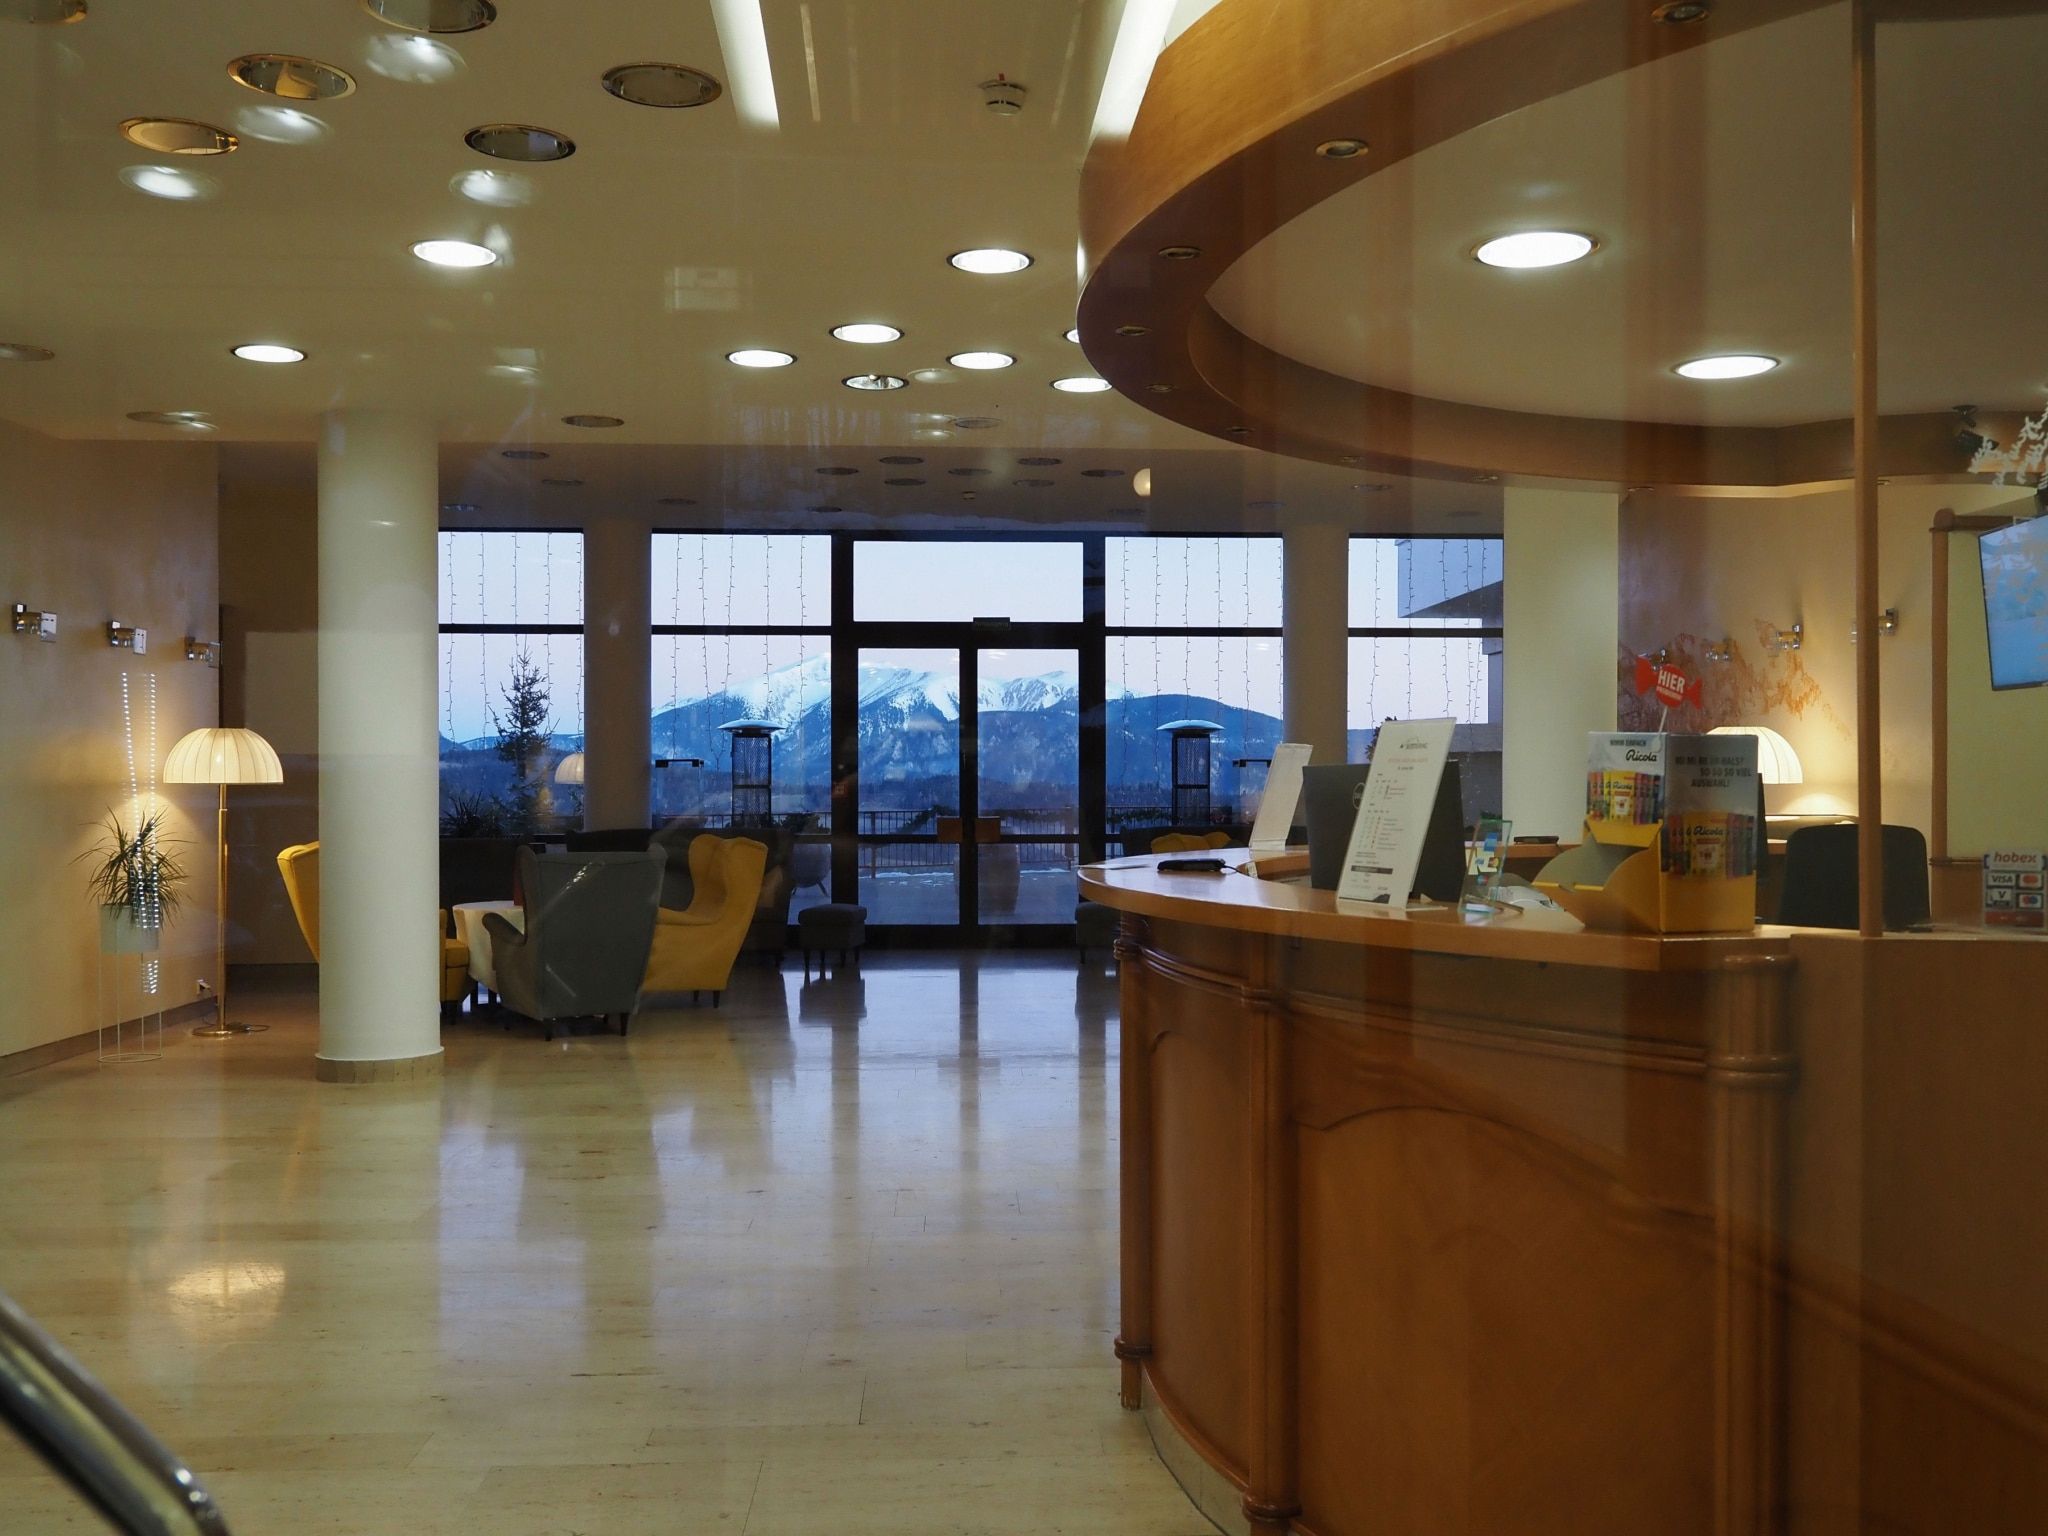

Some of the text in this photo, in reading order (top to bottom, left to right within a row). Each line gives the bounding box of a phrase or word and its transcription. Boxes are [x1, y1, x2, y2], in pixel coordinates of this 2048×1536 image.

[1657, 669, 1685, 694] HIER
[1625, 749, 1657, 761] Ricola
[1693, 825, 1724, 836] Ricola
[1993, 851, 2037, 863] hobex
[1991, 875, 2013, 883] VISA
